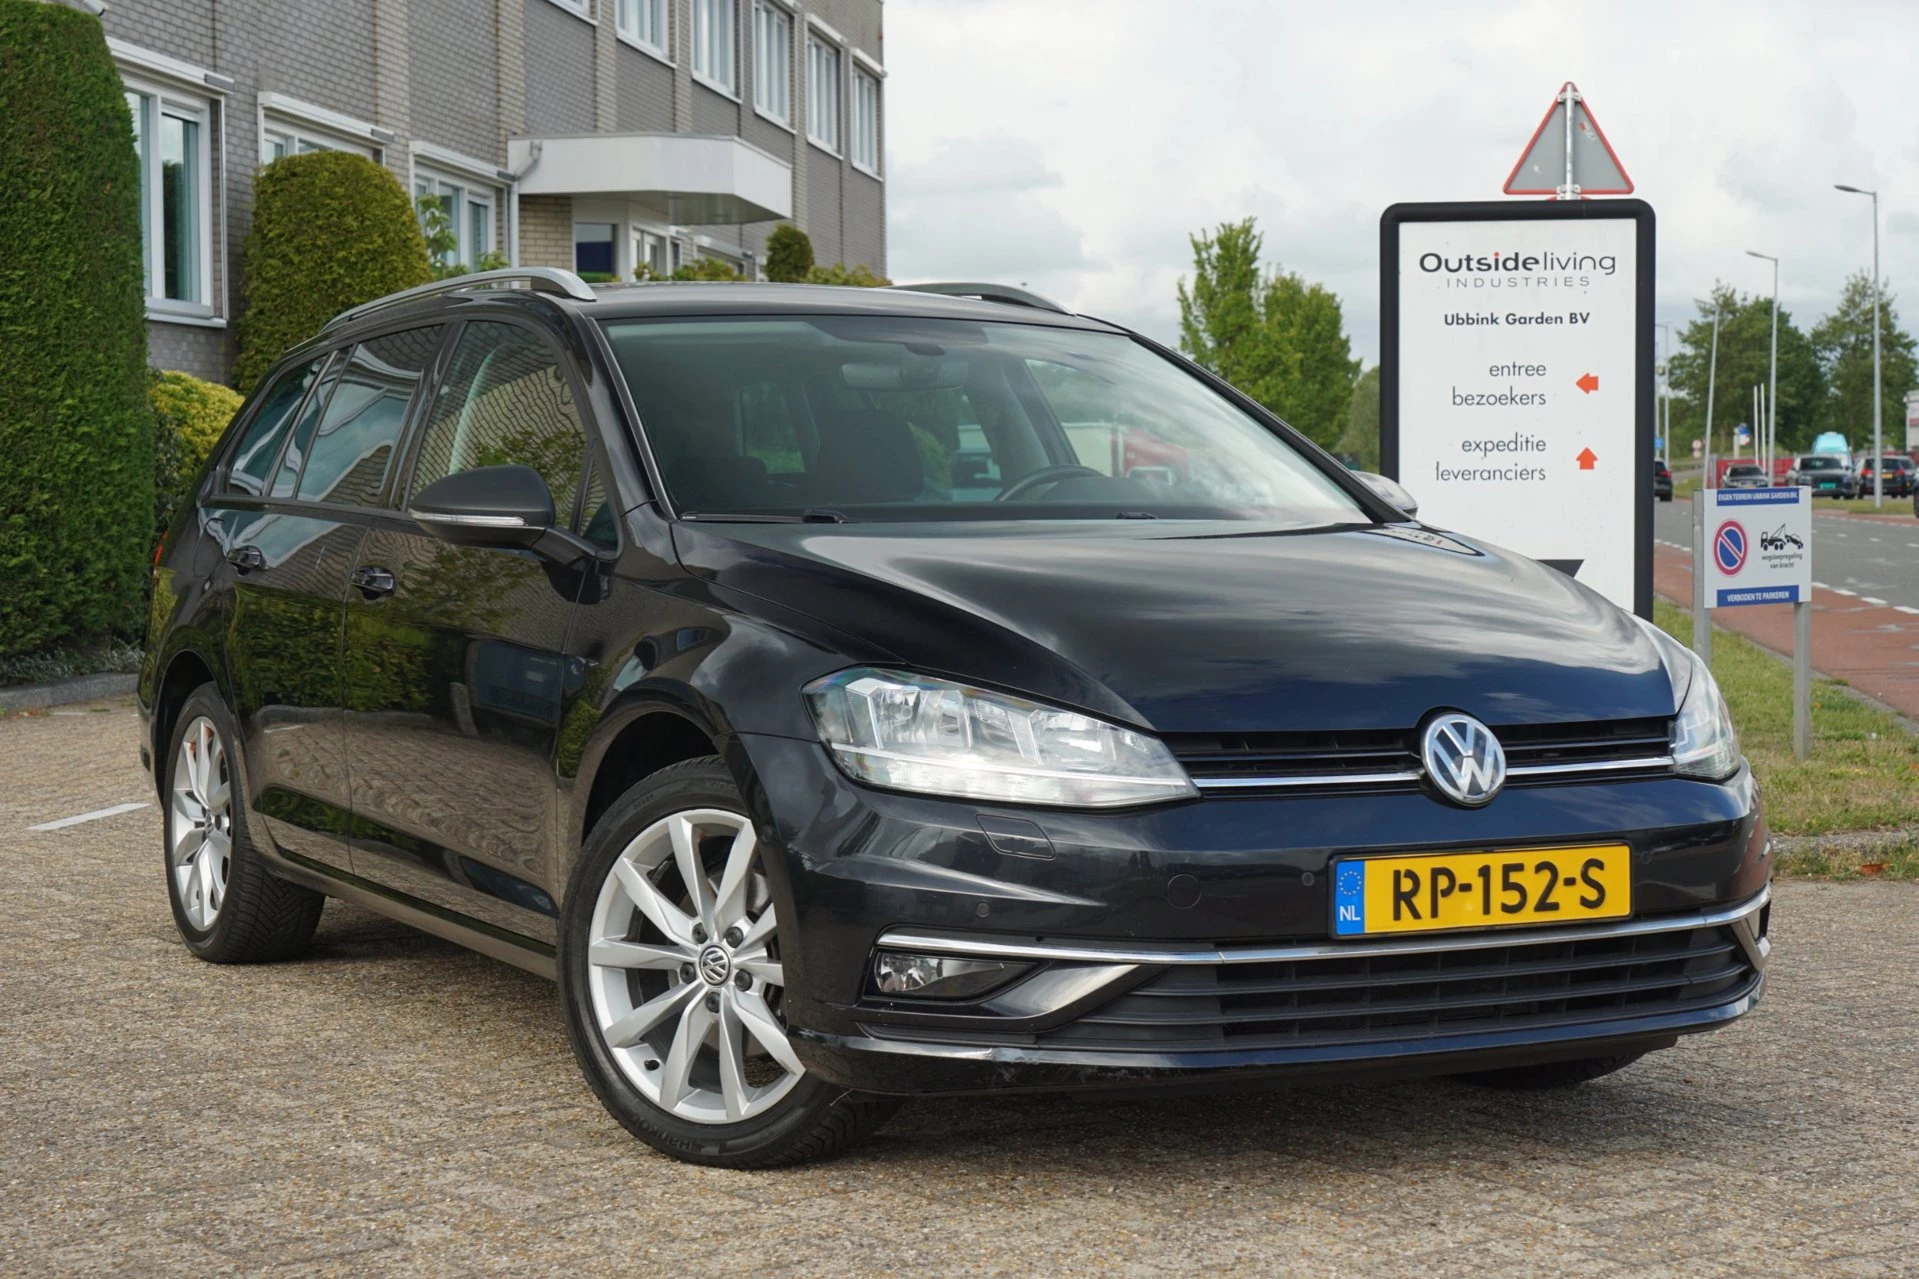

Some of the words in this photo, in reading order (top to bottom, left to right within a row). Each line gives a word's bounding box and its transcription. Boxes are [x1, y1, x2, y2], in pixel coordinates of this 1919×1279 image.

[1447, 276, 1590, 288] INDUSTRIES
[1444, 313, 1499, 326] Ubbink
[1505, 312, 1563, 325] Garden
[1569, 312, 1590, 324] BV
[1489, 361, 1546, 377] entree
[1452, 386, 1546, 406] bezoekers
[1461, 432, 1546, 457] expeditie
[1436, 461, 1546, 481] leveranciers
[1727, 593, 1755, 602] VERBODEN
[1755, 592, 1762, 601] TE
[1763, 591, 1789, 600] PARKEREN
[1392, 857, 1606, 922] RP-152-S
[1339, 904, 1361, 921] NL
